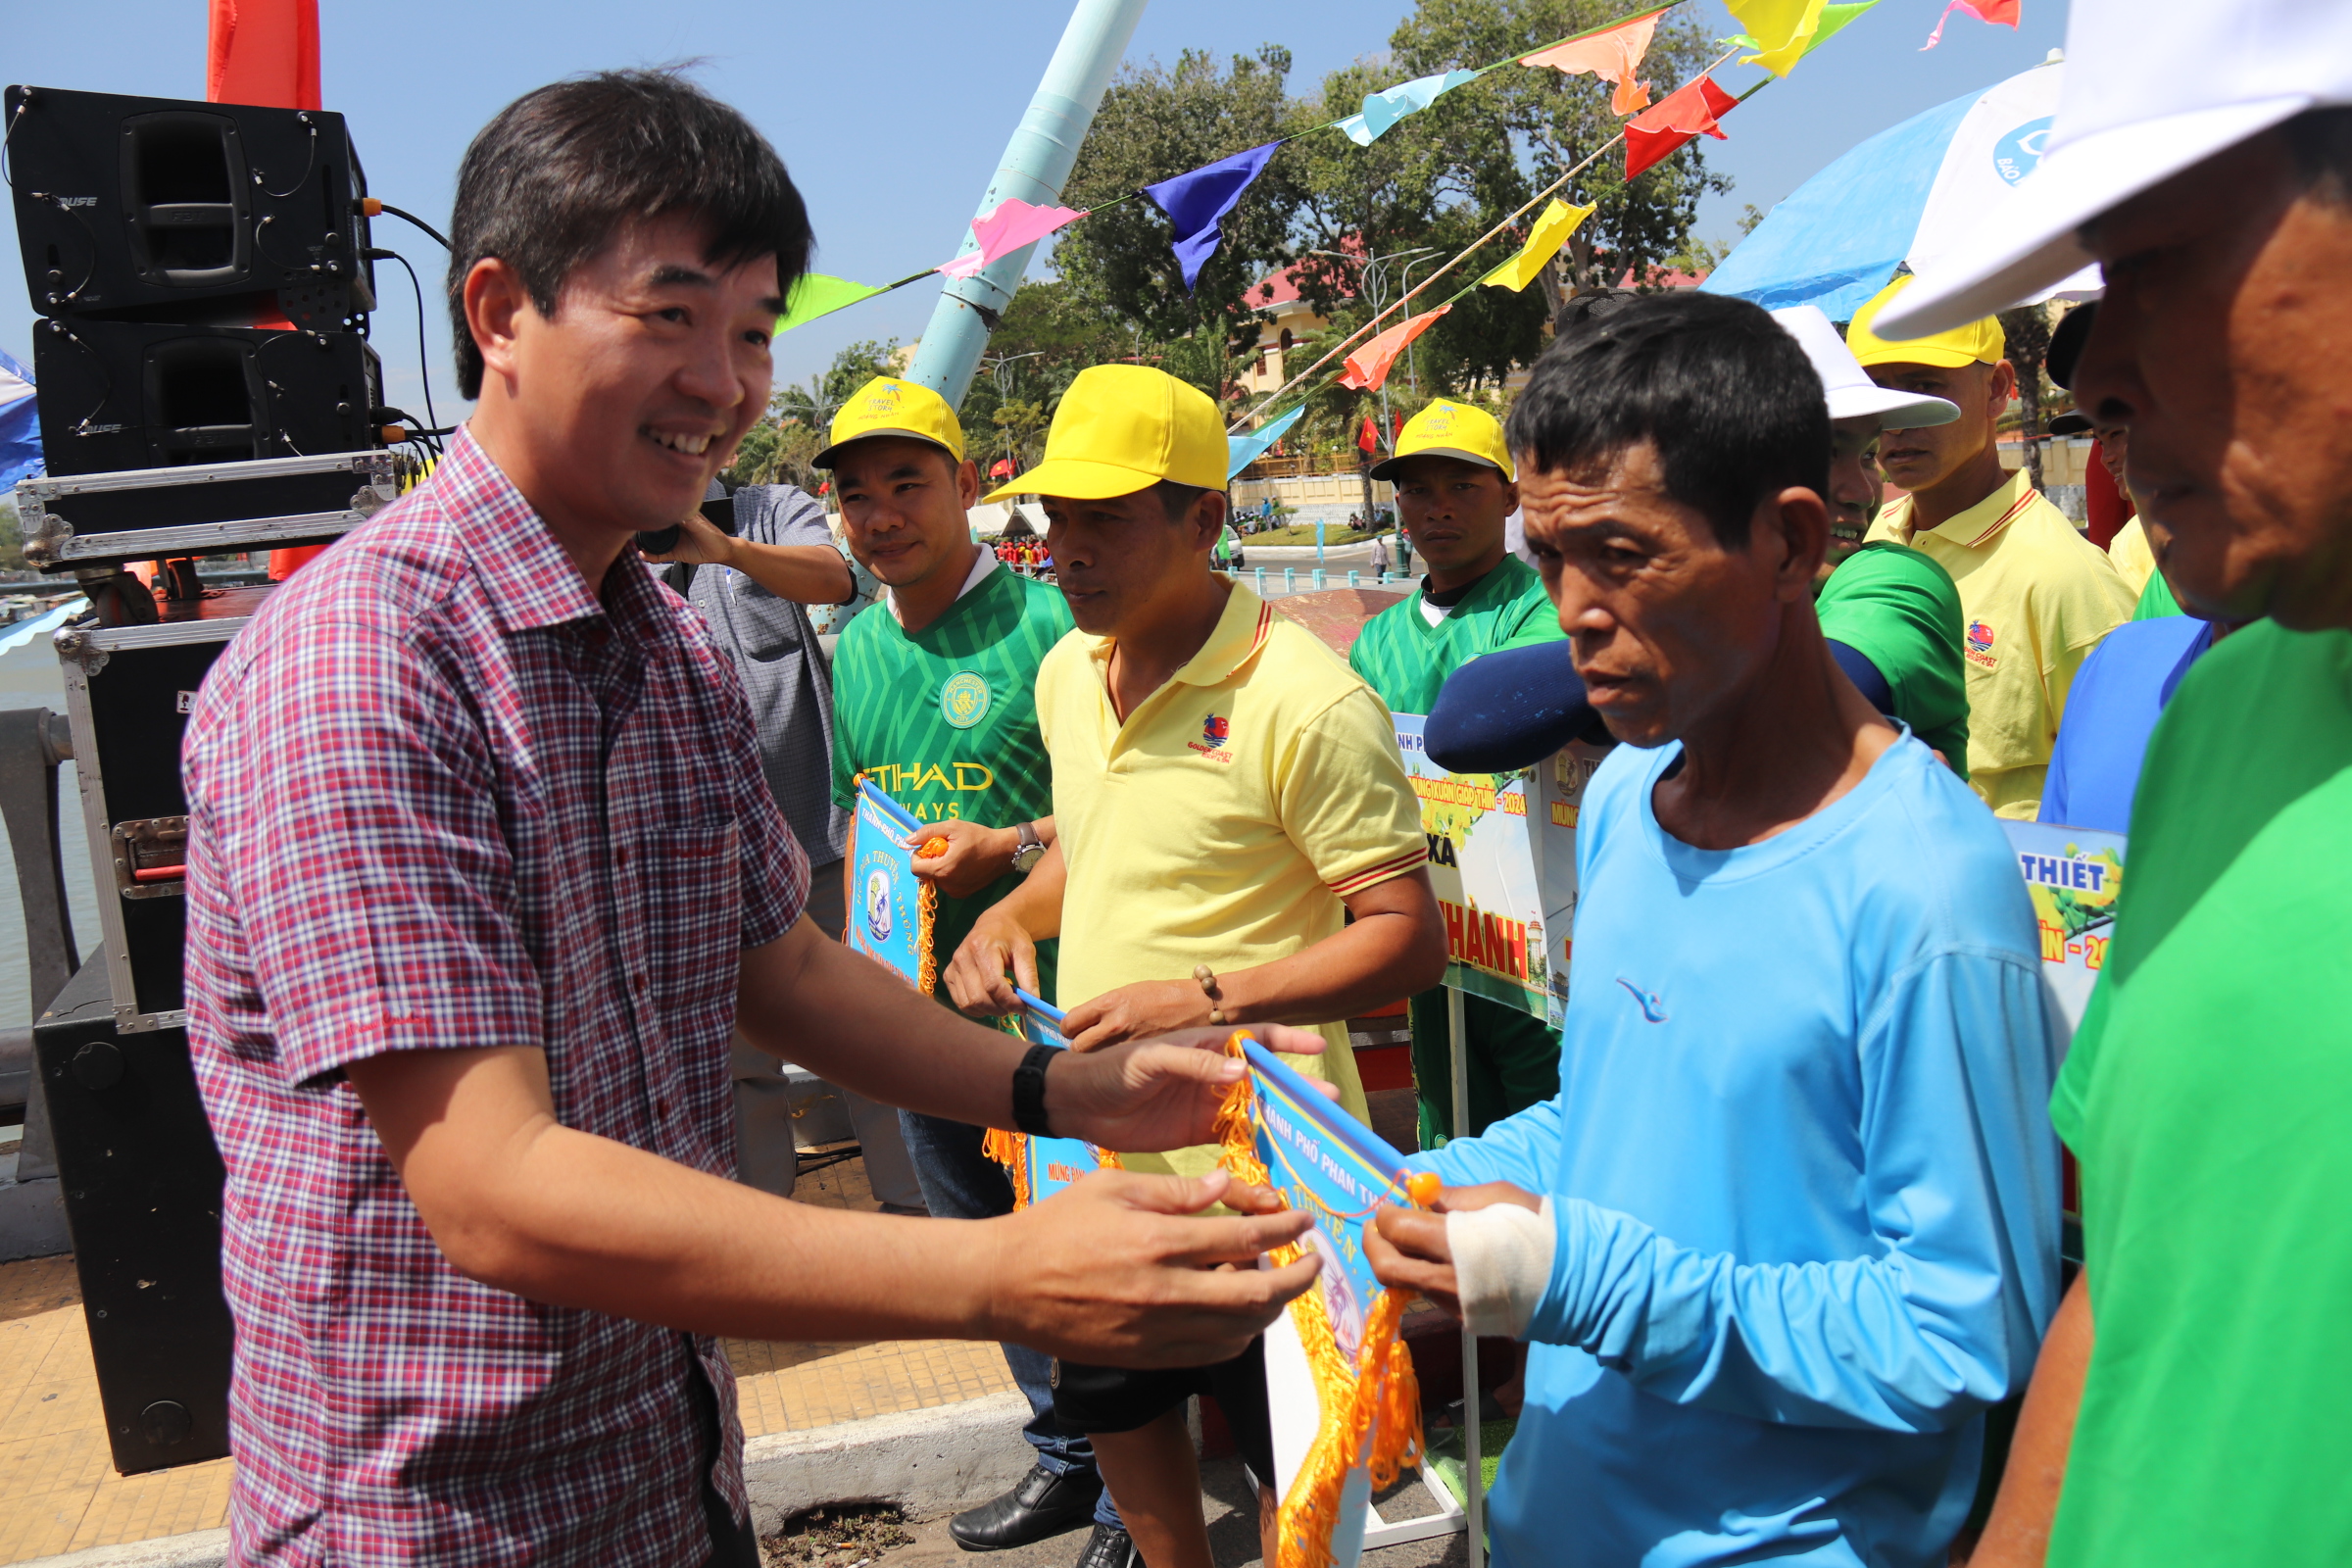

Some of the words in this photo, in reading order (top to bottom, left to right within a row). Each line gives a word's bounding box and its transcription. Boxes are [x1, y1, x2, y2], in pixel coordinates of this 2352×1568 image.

[868, 404, 893, 413] STORY
[949, 678, 984, 694] MANCHESTER
[1187, 741, 1212, 753] GOLDEN
[1211, 749, 1234, 760] COAST
[1432, 777, 1455, 804] XUÂN
[1456, 780, 1475, 808] GIÁP
[1475, 784, 1497, 811] THÌN
[1502, 791, 1528, 817] 2024
[1426, 829, 1458, 869] XÃ
[2020, 852, 2105, 893] THIẾT
[1438, 895, 1531, 982] HÀNH
[2039, 919, 2066, 963] ÌN
[1048, 1159, 1070, 1183] MỪNG
[1295, 1128, 1321, 1164] PHỐ
[1320, 1152, 1356, 1197] PHAN
